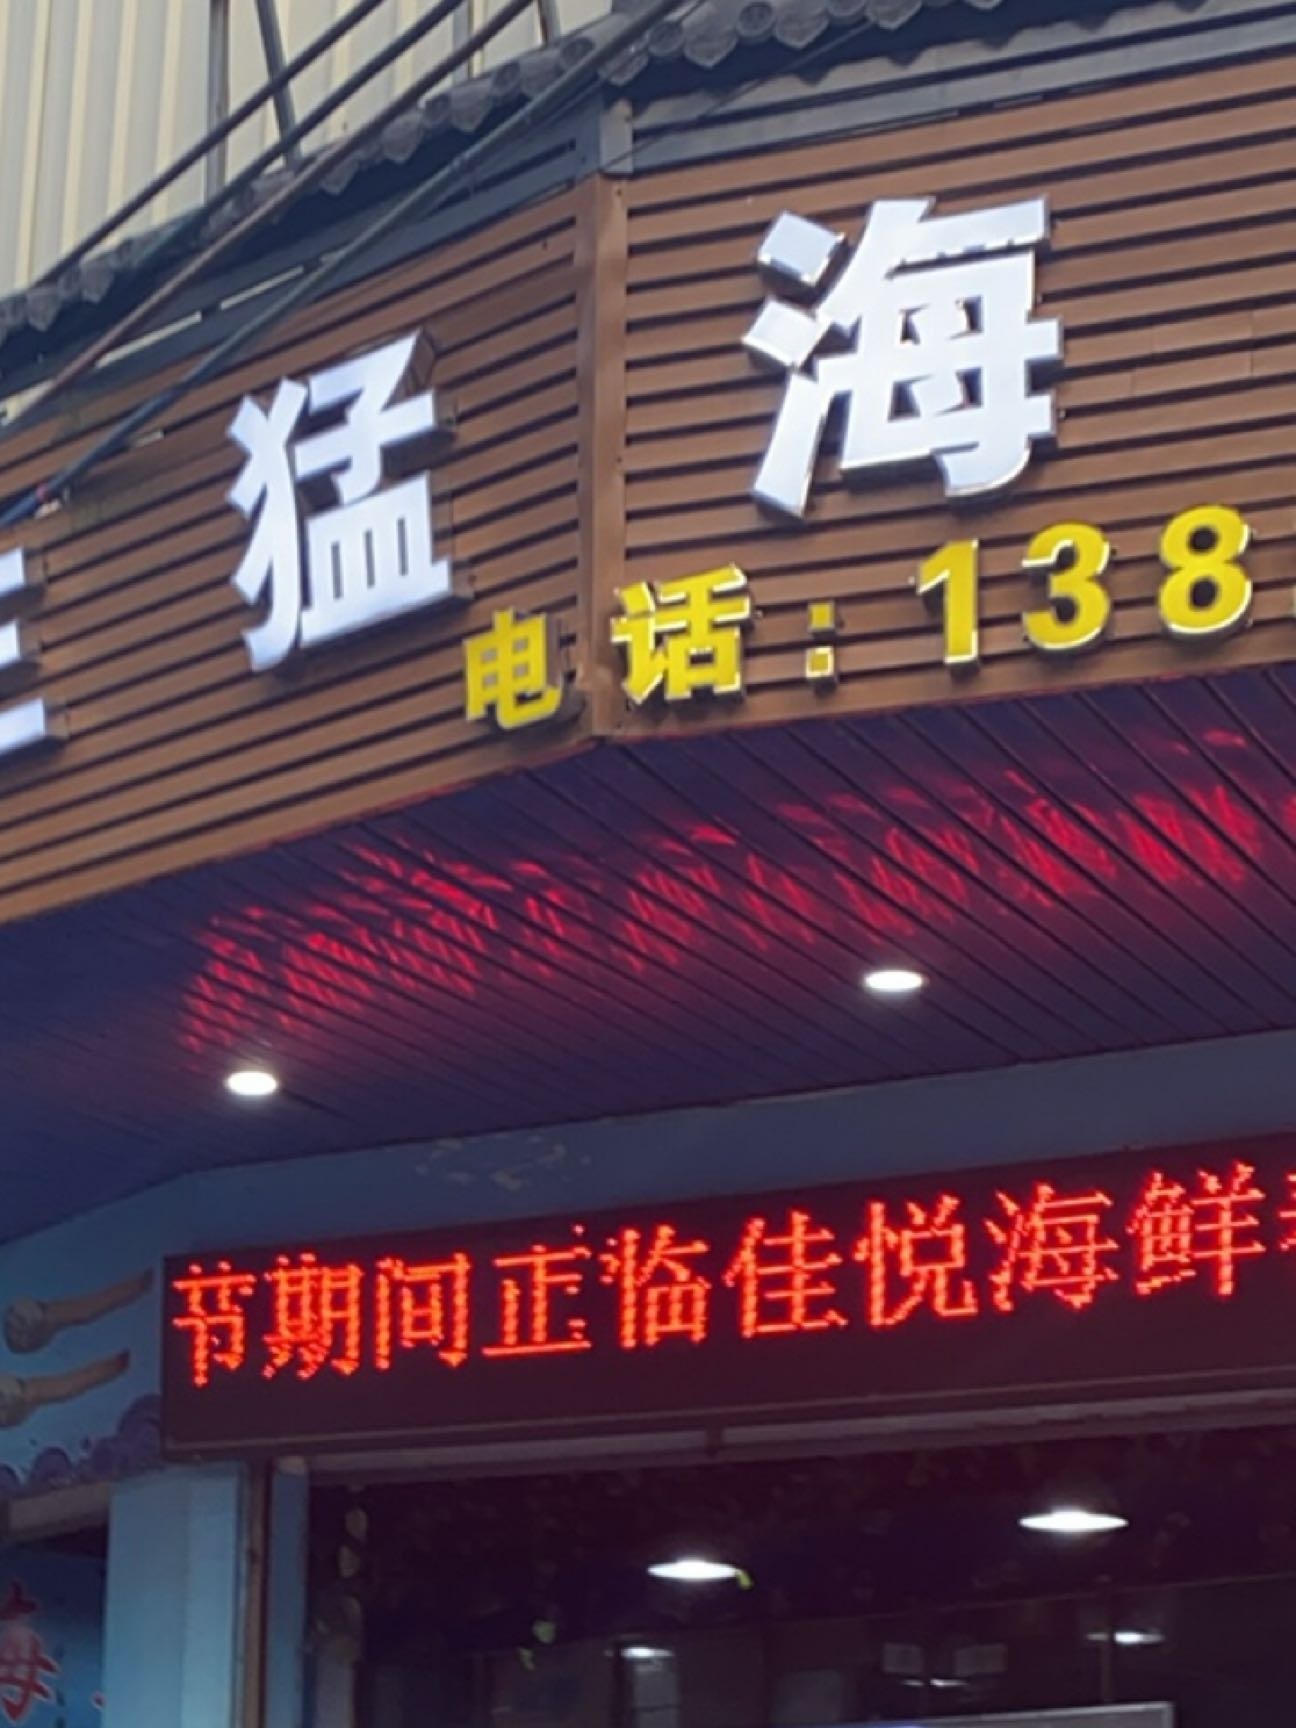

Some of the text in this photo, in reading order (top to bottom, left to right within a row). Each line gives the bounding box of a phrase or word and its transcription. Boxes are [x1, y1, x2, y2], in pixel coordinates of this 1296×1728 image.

[171, 1162, 1296, 1388] 节期间正临佳悦海鲜
